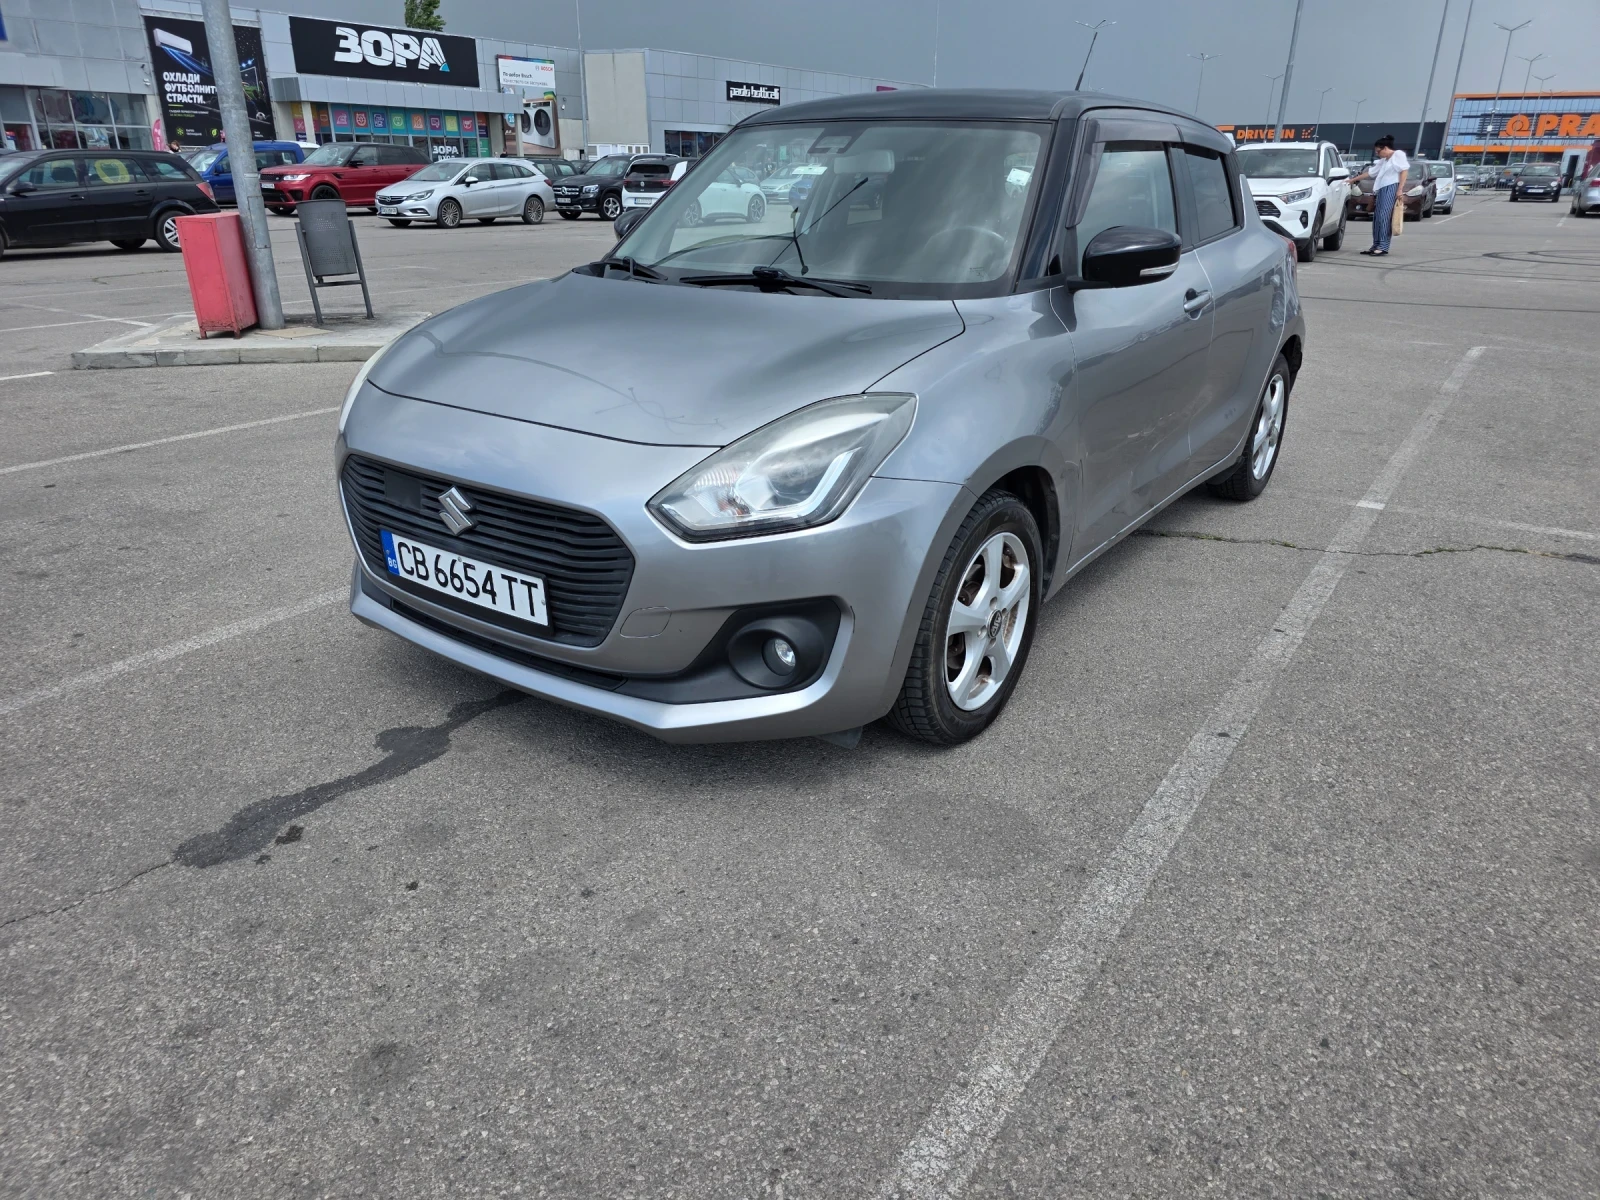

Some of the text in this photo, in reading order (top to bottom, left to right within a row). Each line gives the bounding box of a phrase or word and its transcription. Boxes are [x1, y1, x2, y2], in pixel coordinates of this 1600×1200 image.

[334, 26, 450, 71] ЗОРА
[163, 71, 200, 83] ОХЛАДИ
[164, 83, 217, 94] ФУТБОЛНИТ
[730, 85, 779, 100] paolo botticelli
[166, 94, 206, 104] СТРАСТИ.
[1236, 129, 1275, 139] DRIVE
[432, 145, 459, 155] ЗОРА
[387, 557, 398, 569] BG
[397, 541, 539, 617] CB 6654 TT
